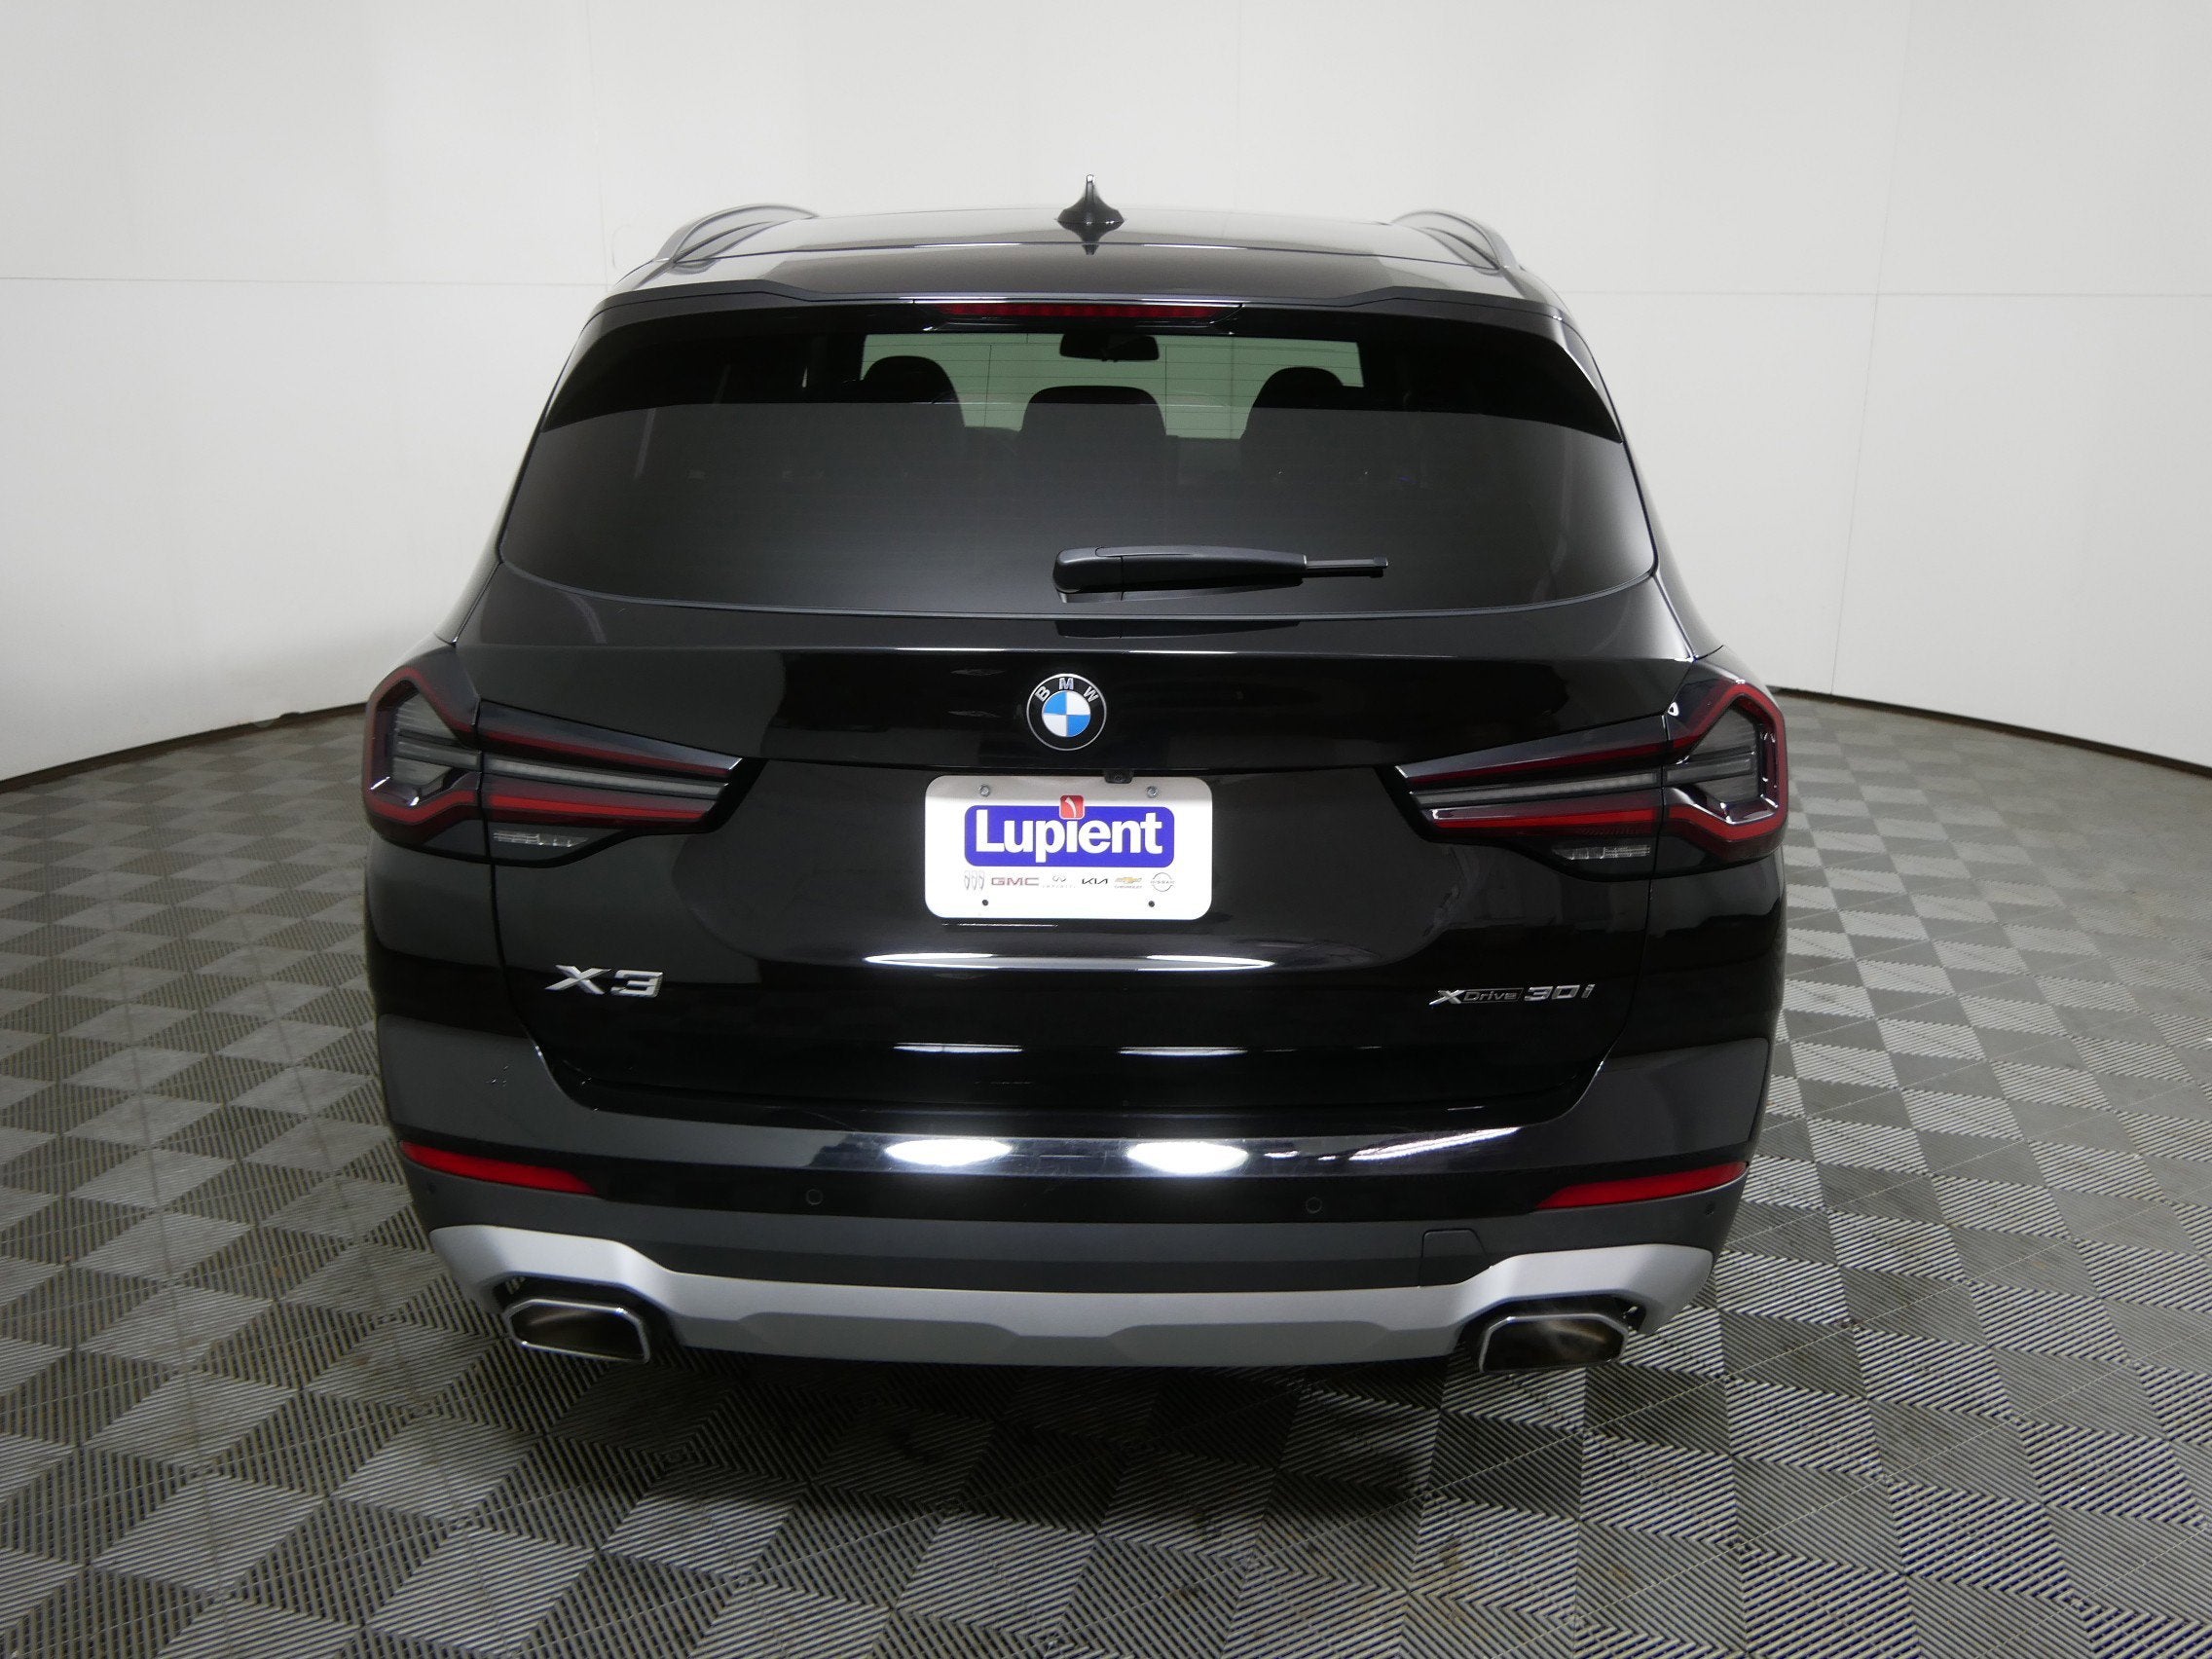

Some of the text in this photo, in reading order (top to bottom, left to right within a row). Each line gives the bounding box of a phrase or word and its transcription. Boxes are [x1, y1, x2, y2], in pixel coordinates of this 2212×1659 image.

[1034, 677, 1100, 703] BMW
[975, 808, 1164, 864] Lupient
[991, 876, 1040, 886] GMC
[544, 964, 664, 998] X3
[1524, 983, 1596, 1002] 30i
